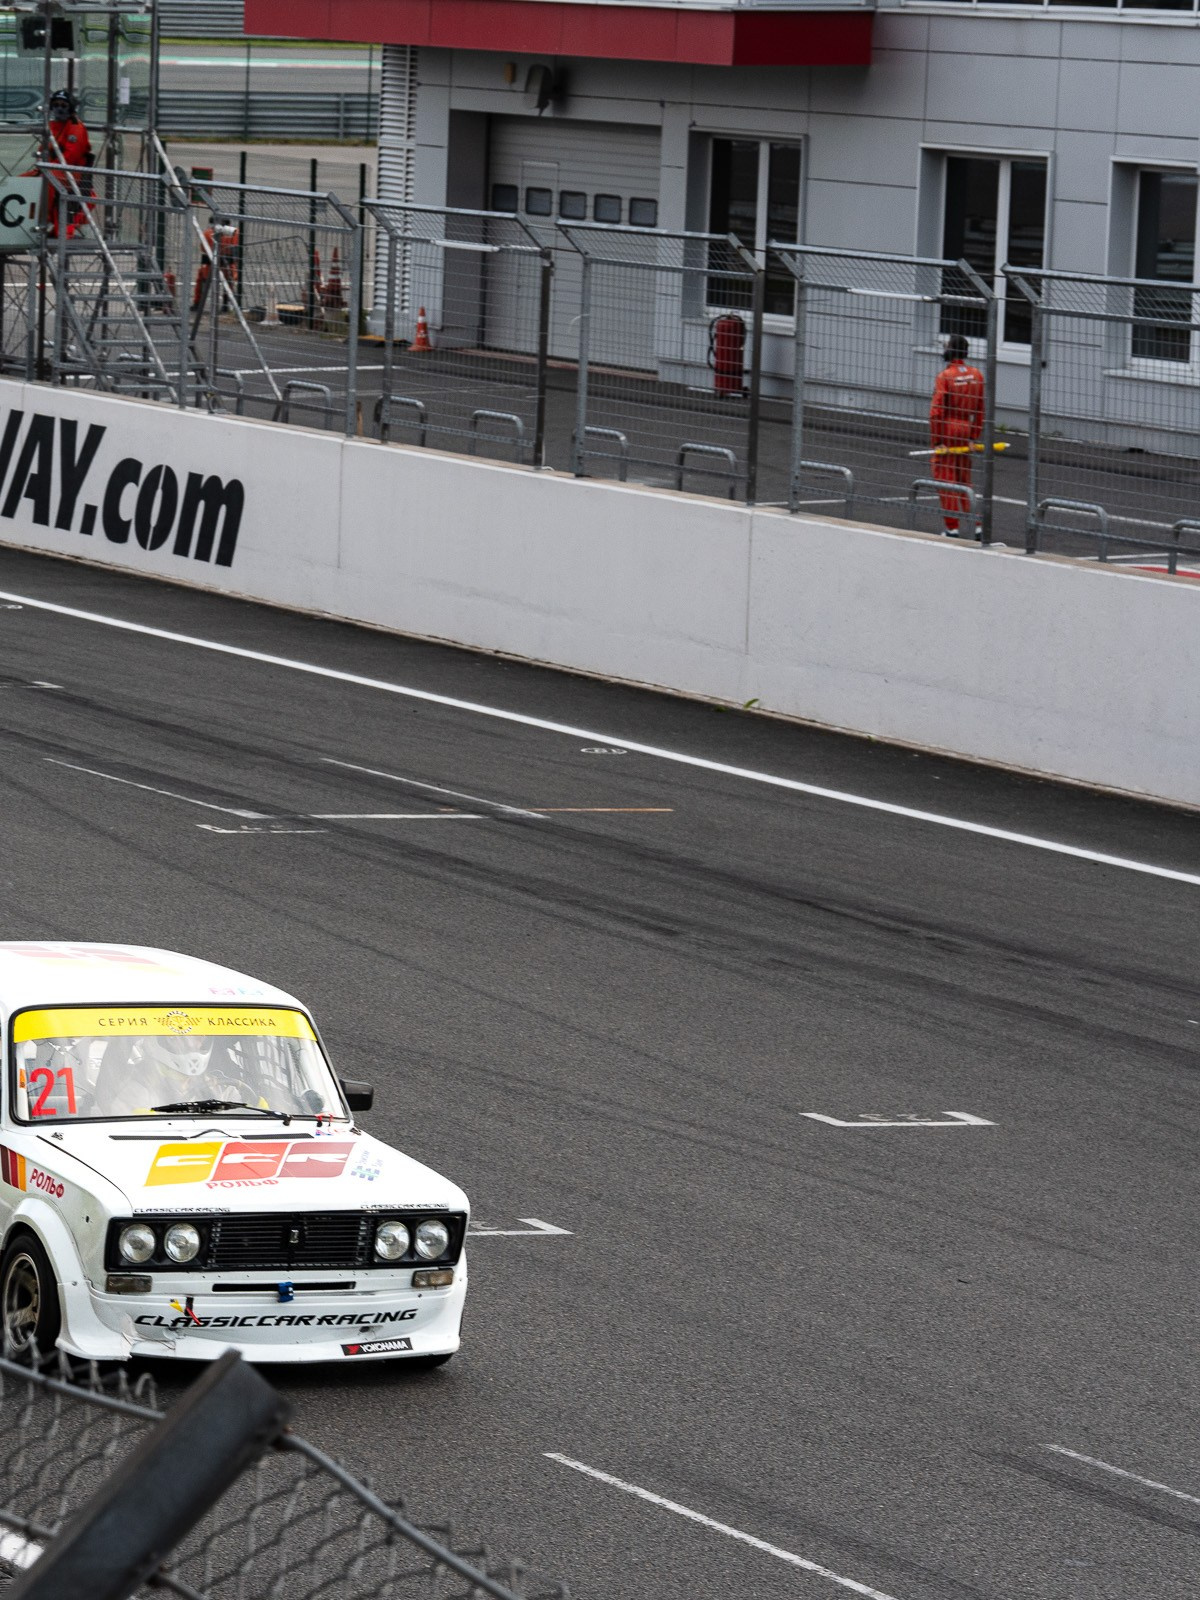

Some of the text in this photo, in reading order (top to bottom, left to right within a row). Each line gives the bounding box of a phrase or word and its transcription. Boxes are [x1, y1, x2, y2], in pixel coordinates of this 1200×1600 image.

[98, 1017, 277, 1027] СЕРИЯ КЛАССИКА
[29, 1067, 77, 1116] 21
[29, 1168, 65, 1199] РОЛЬФ
[205, 1180, 279, 1190] РОЛЬФ
[360, 1339, 408, 1353] YOKOHAMA
